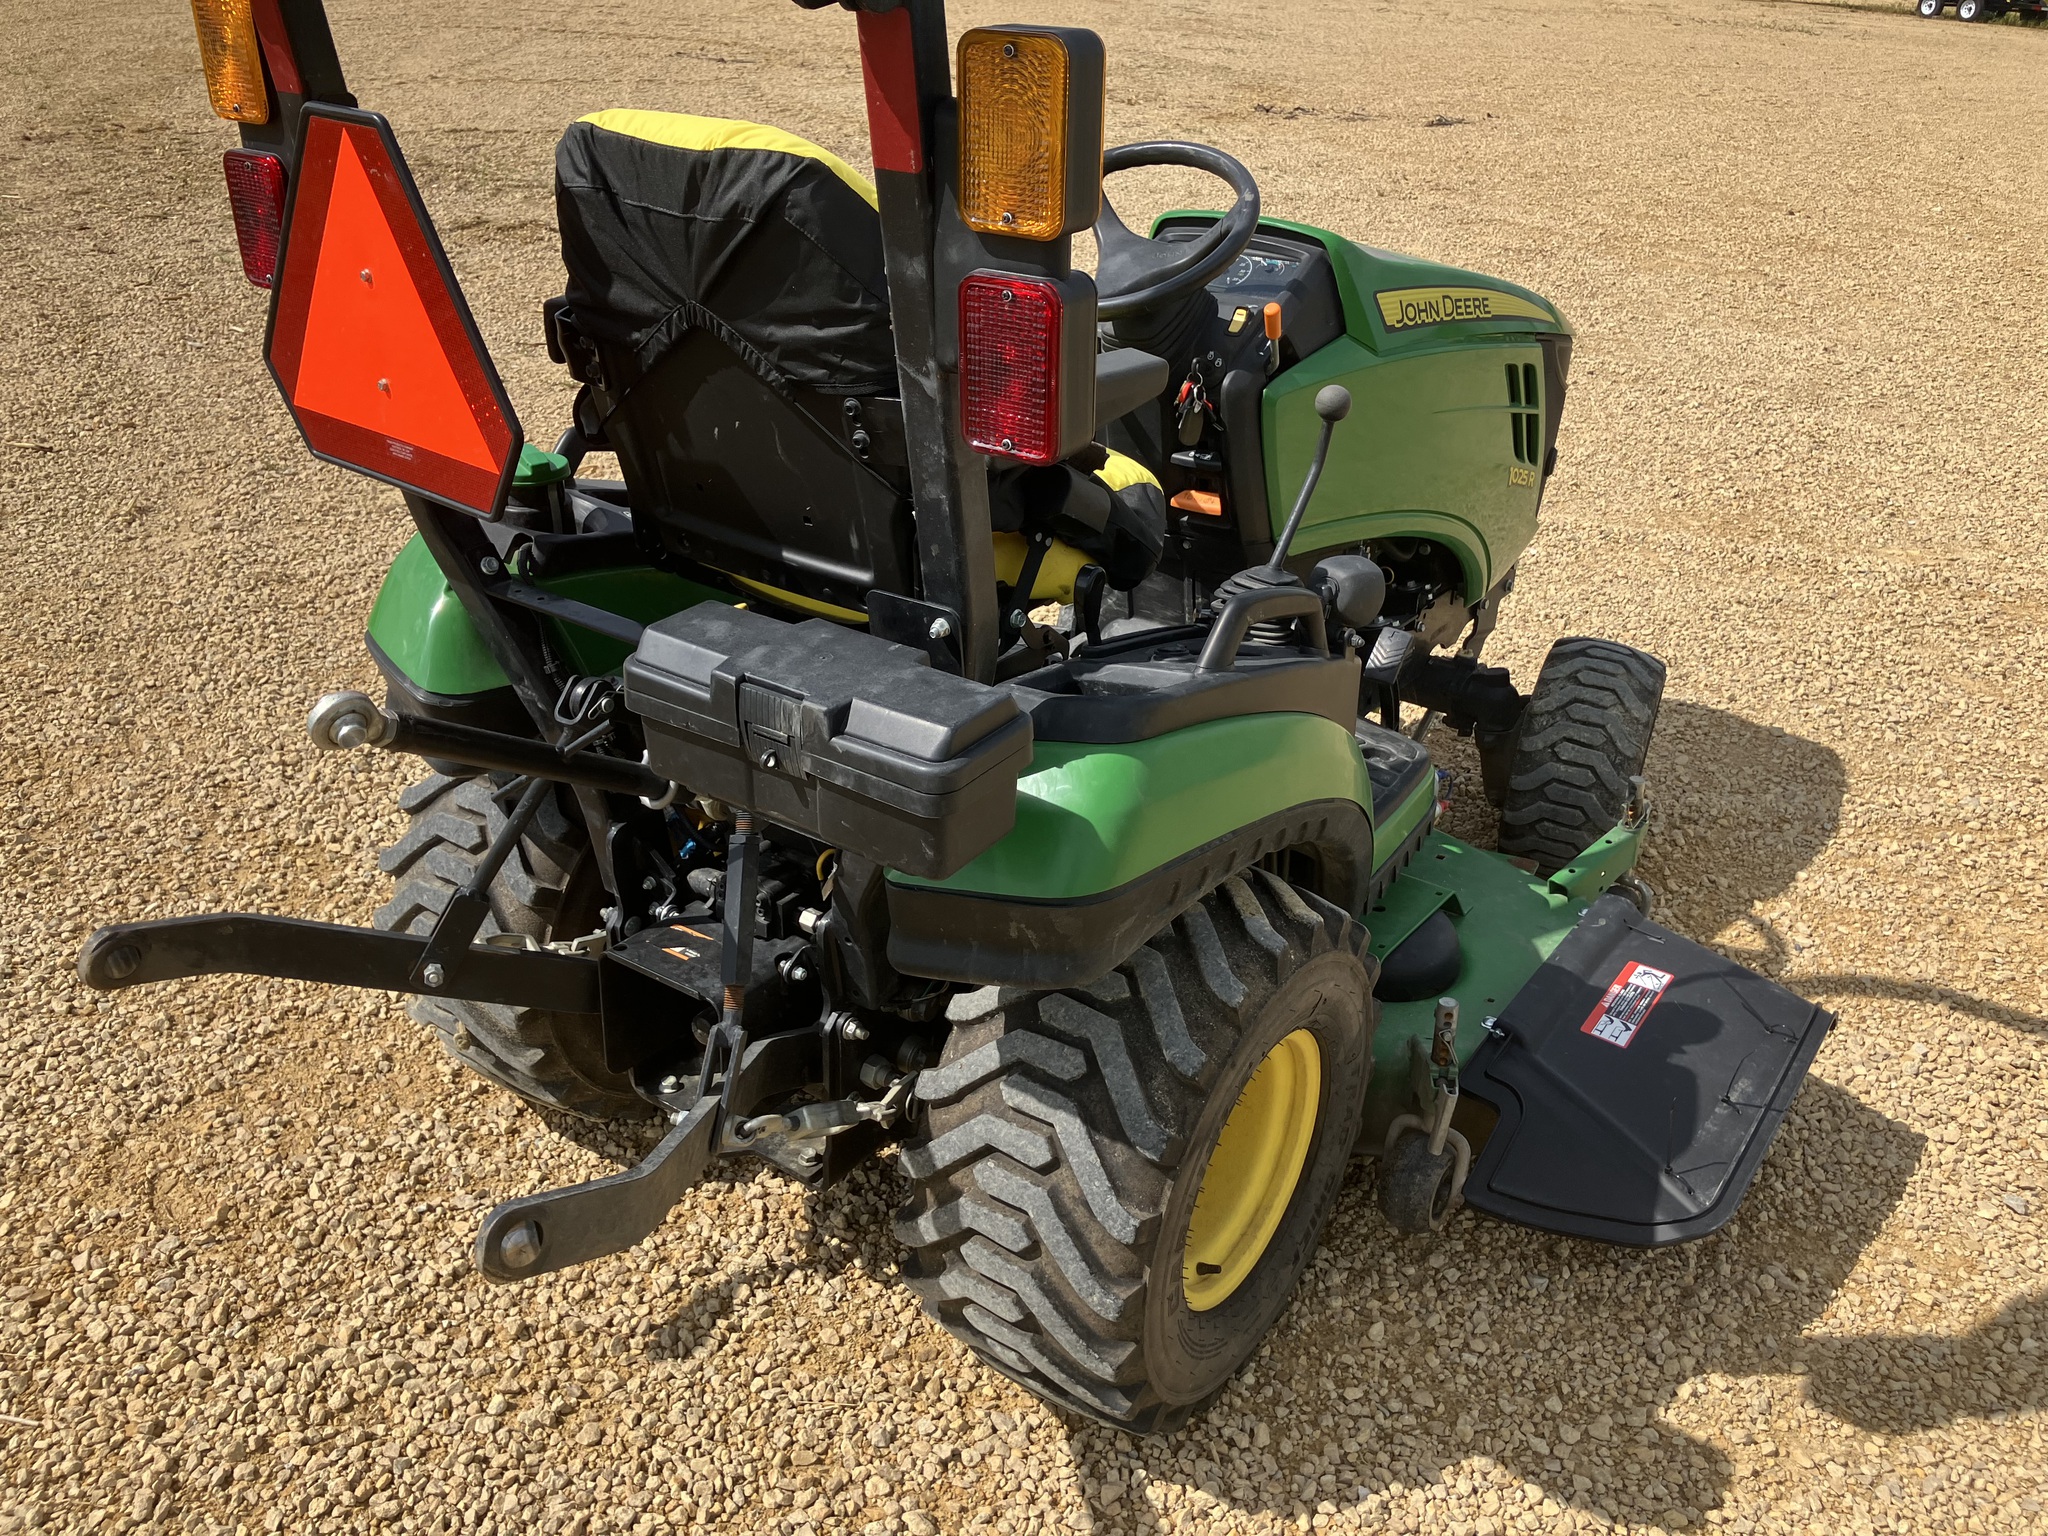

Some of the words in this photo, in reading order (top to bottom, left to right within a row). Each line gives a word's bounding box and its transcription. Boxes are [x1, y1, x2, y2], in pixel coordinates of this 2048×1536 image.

[1396, 299, 1440, 325] JOHN
[1441, 295, 1492, 318] DEERE
[1508, 466, 1536, 488] 1025R
[1603, 983, 1622, 1005] DANGER
